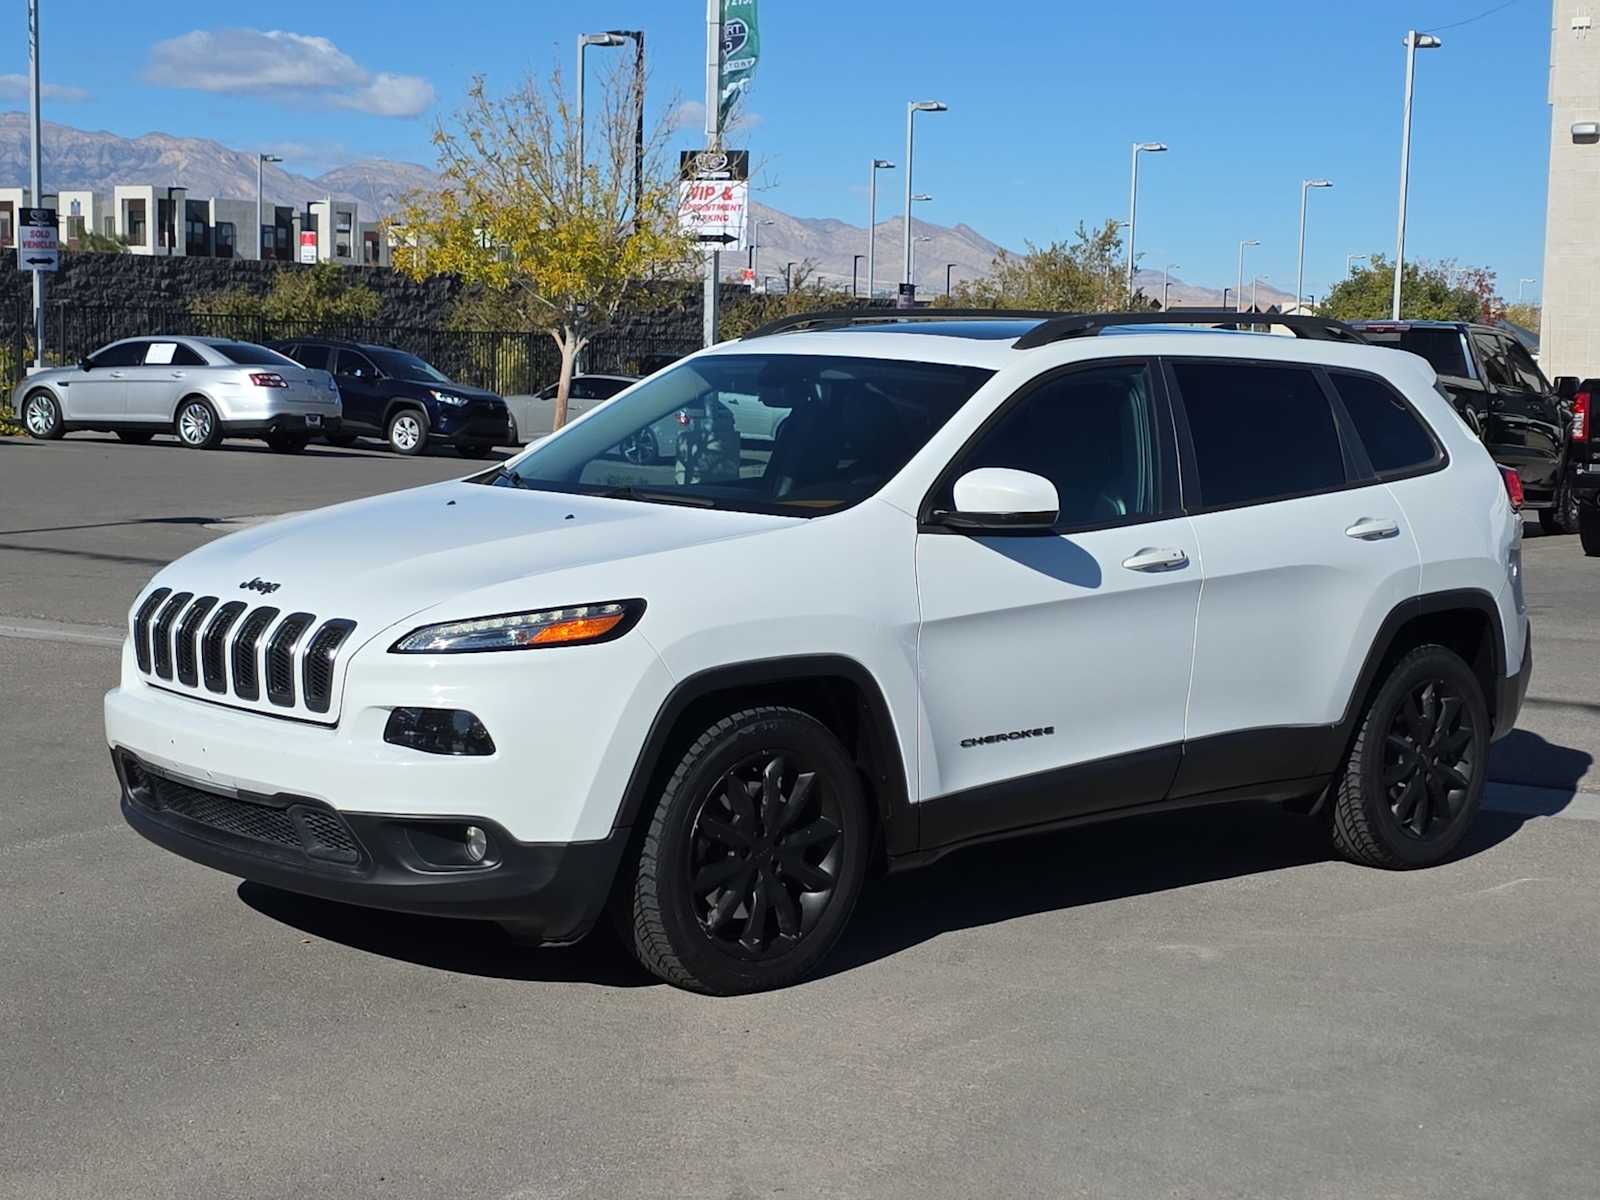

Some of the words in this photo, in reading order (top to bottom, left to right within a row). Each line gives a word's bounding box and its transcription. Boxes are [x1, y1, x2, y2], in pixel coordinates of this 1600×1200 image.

[690, 186, 715, 200] VIP
[721, 186, 732, 200] &
[30, 229, 49, 239] SOLD
[23, 240, 57, 249] VEHICLES
[239, 577, 281, 595] Jeep
[960, 726, 1055, 748] CHEROKEE
